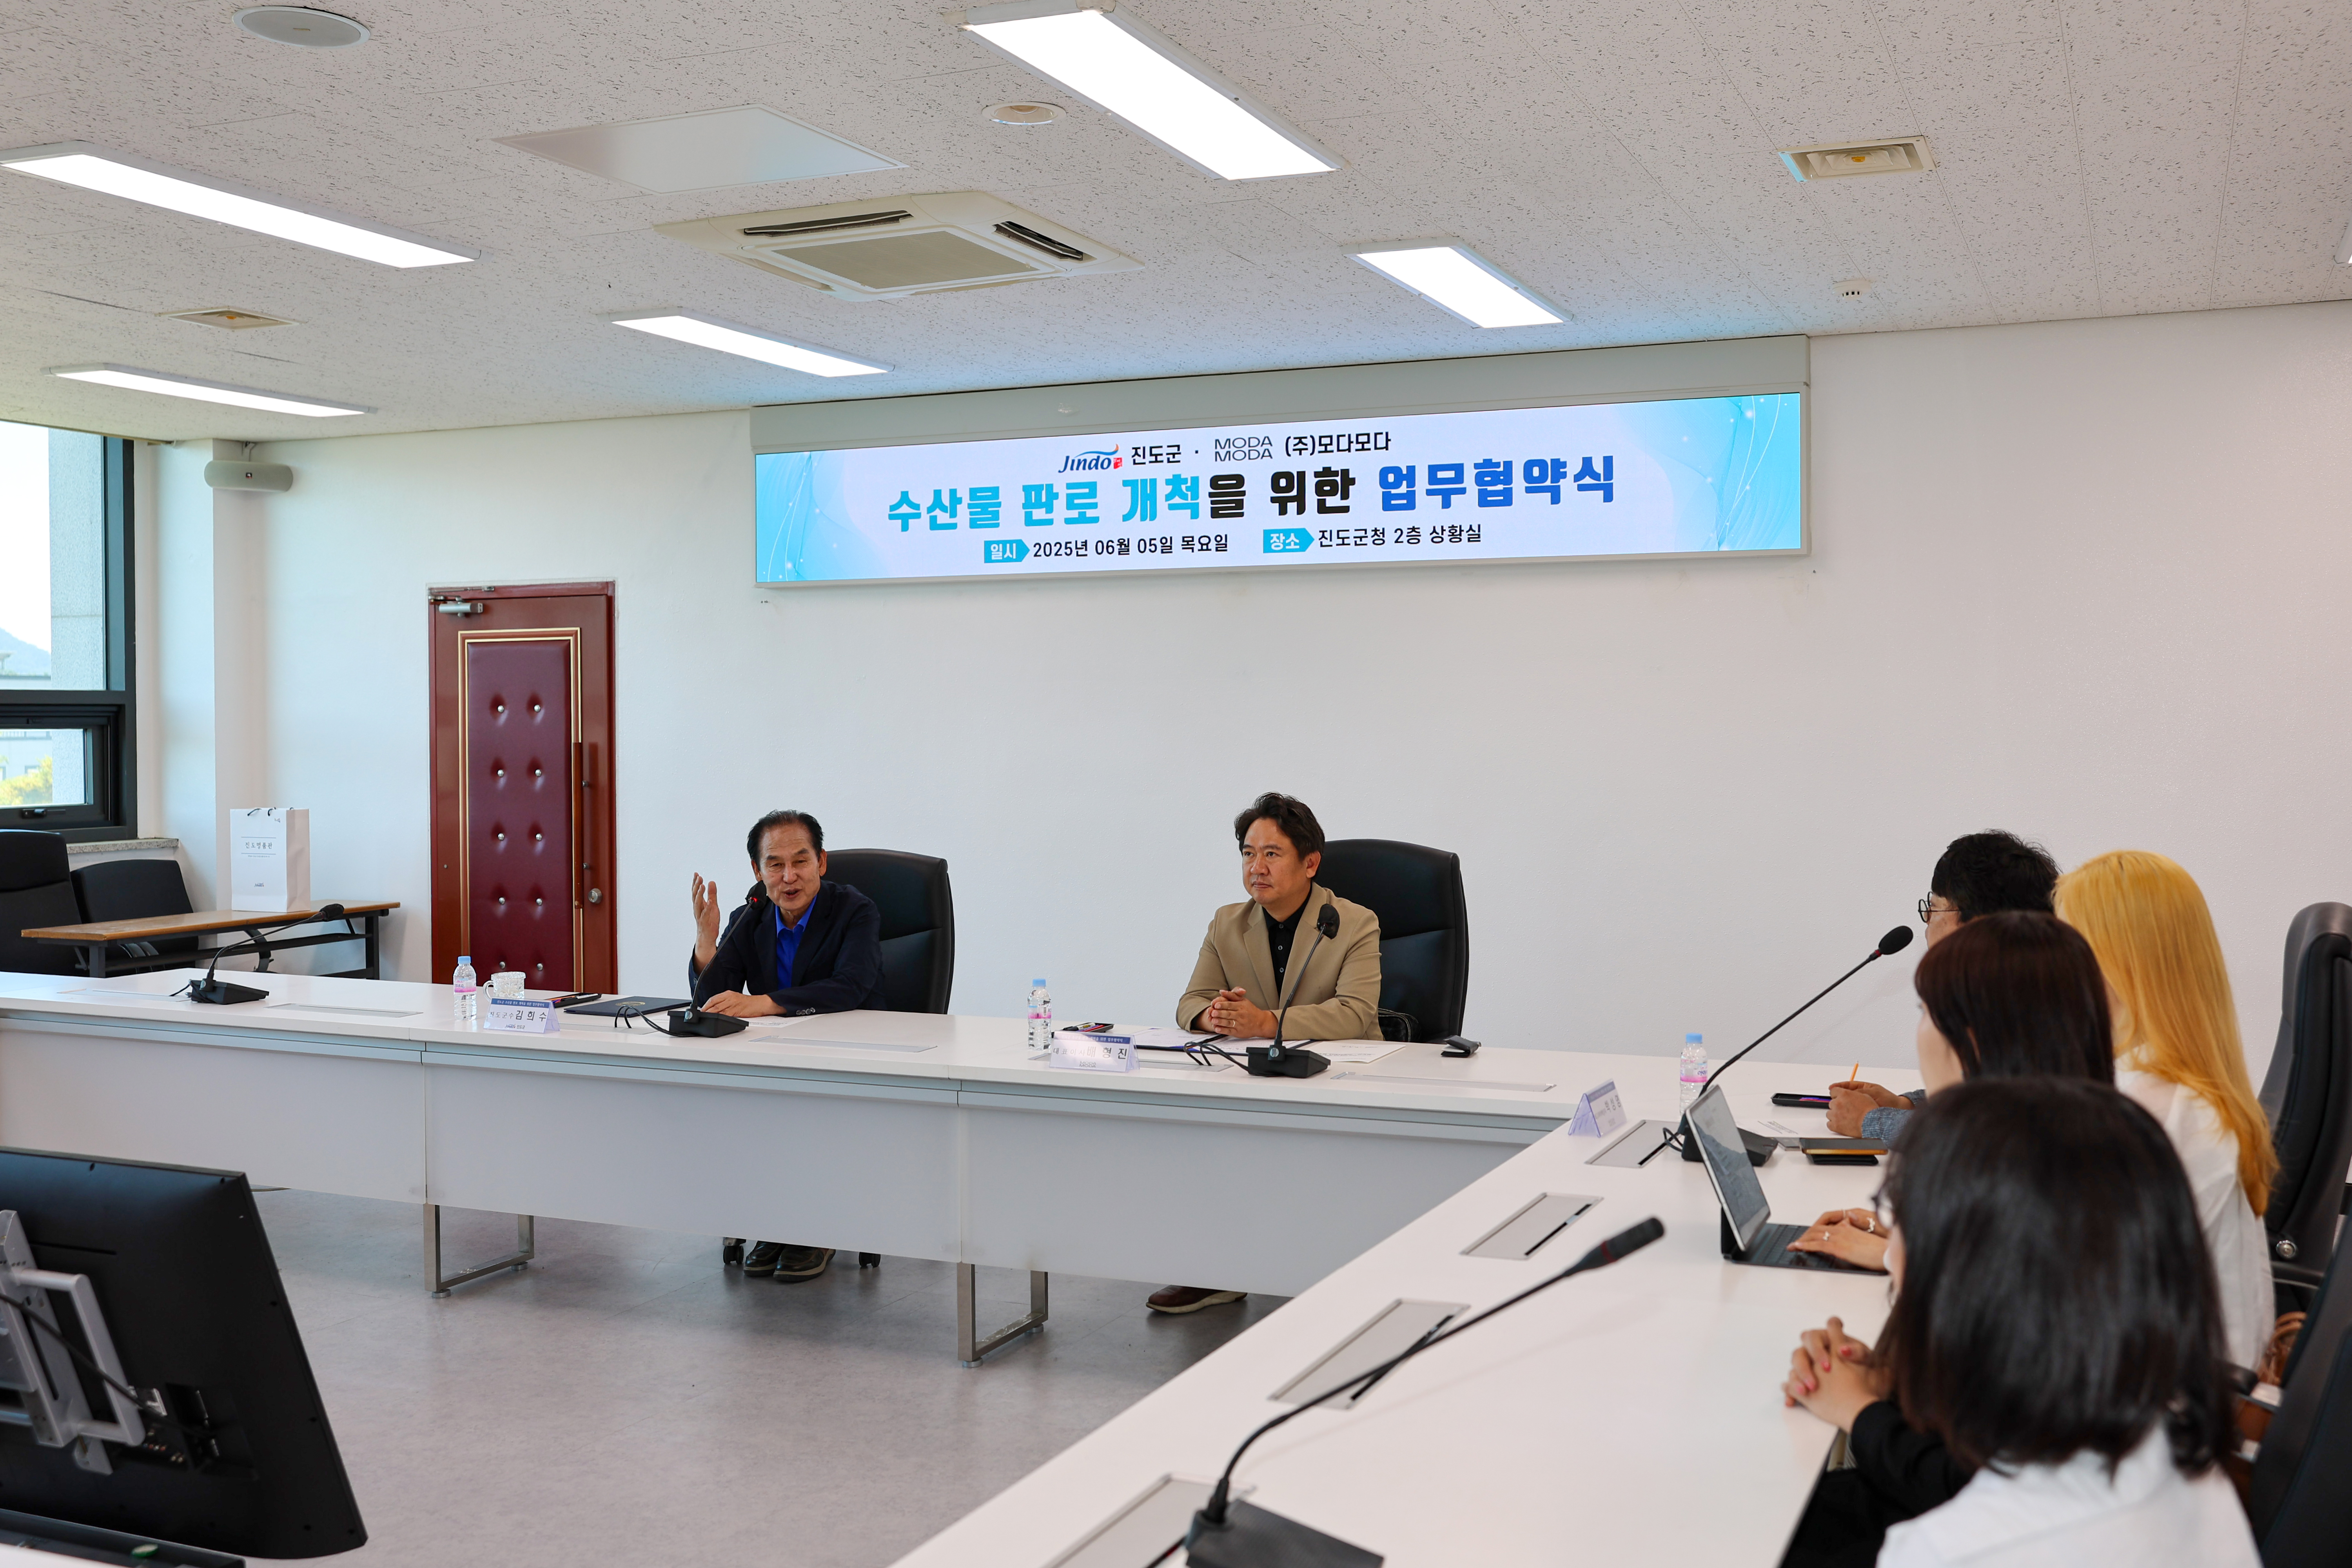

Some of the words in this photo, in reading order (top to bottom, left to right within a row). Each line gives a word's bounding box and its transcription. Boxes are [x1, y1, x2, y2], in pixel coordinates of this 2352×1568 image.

[1214, 436, 1273, 449] MODA
[1285, 431, 1392, 457] (주)모다모다
[1058, 455, 1112, 473] Jindo
[1131, 445, 1181, 466] 진도군
[1214, 448, 1273, 462] MODA
[888, 486, 1002, 532] 수산물
[1022, 481, 1100, 527] 판로
[1122, 473, 1247, 523] 개척을
[1270, 466, 1356, 516] 위한
[1378, 455, 1614, 512] 업무협약식
[990, 543, 1016, 560] 일시
[1033, 539, 1088, 557] 2025년
[1095, 537, 1130, 556] 06월
[1137, 536, 1173, 554] 05일
[1181, 534, 1228, 553] 목요일
[1270, 533, 1300, 550] 장소
[1318, 527, 1386, 548] 진도군청
[1394, 526, 1422, 545] 2층
[1429, 524, 1481, 544] 상황실
[1053, 1047, 1085, 1056] 대표이사
